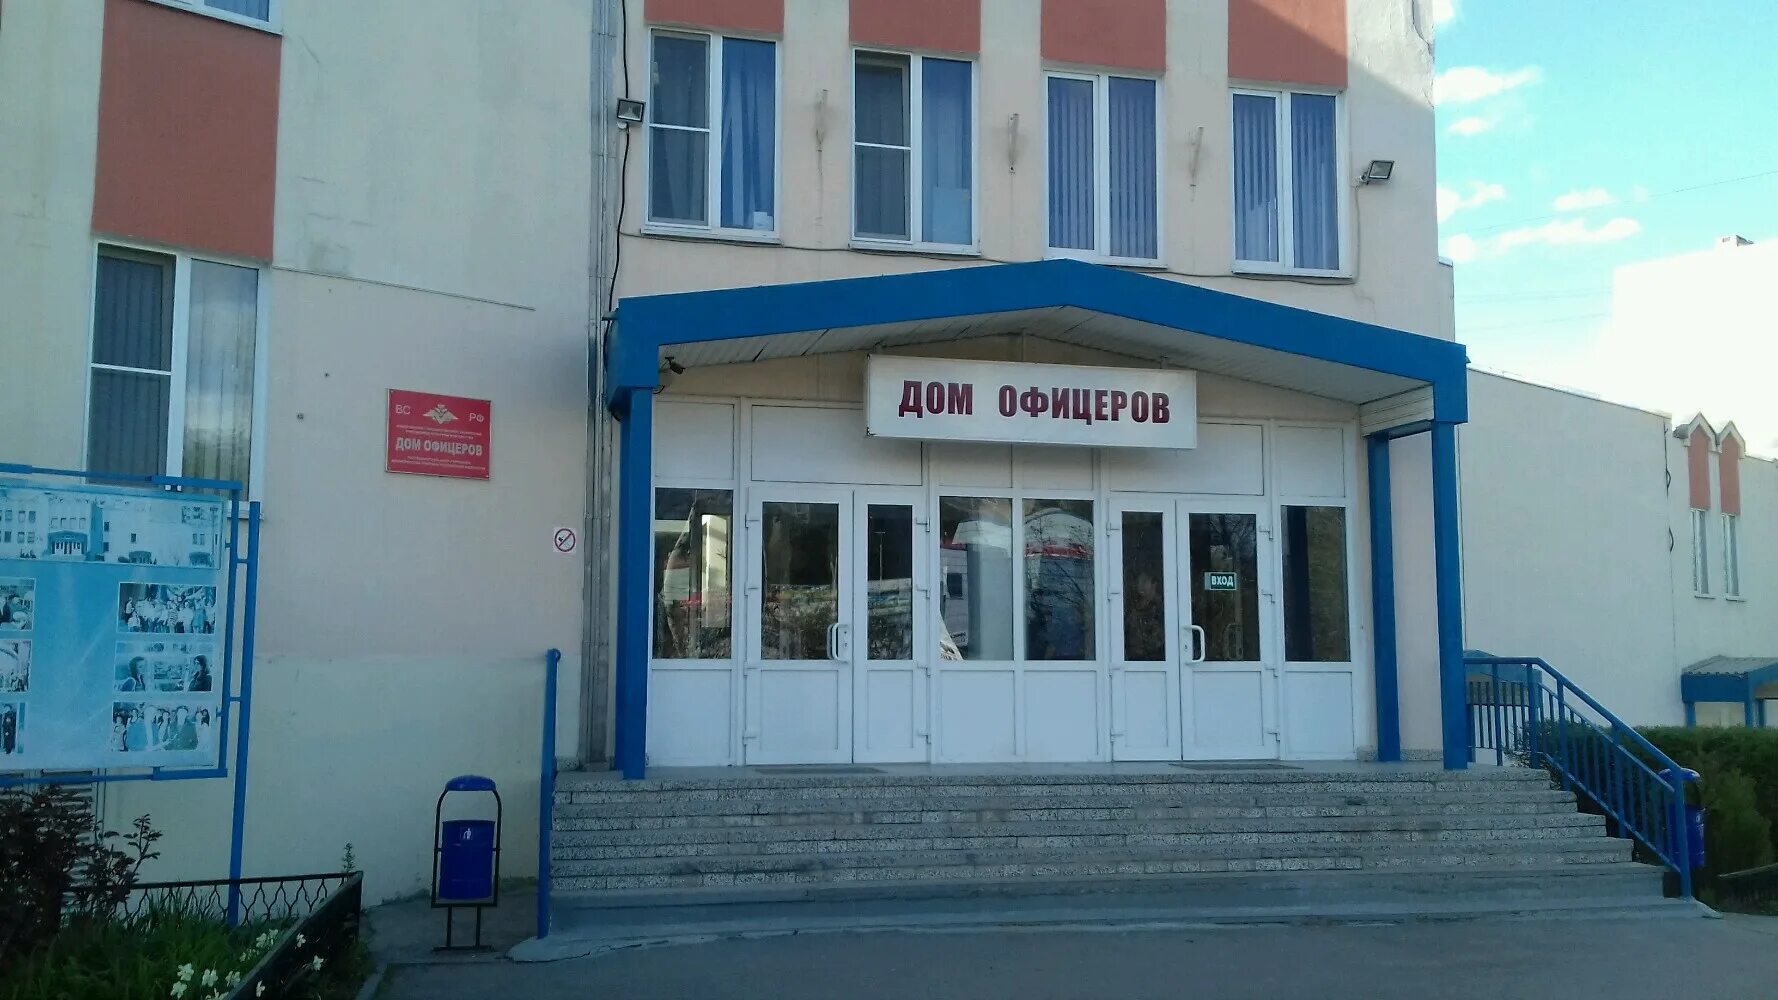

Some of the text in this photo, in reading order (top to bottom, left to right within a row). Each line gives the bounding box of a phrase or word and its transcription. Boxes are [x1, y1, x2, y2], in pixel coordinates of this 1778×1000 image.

[898, 380, 1170, 425] ДОМ ОФИЦЕРОВ
[395, 404, 484, 423] ВС РФ
[396, 437, 483, 456] ДОМ ОФИЦЕРОВ
[1211, 575, 1234, 587] ВХОД
